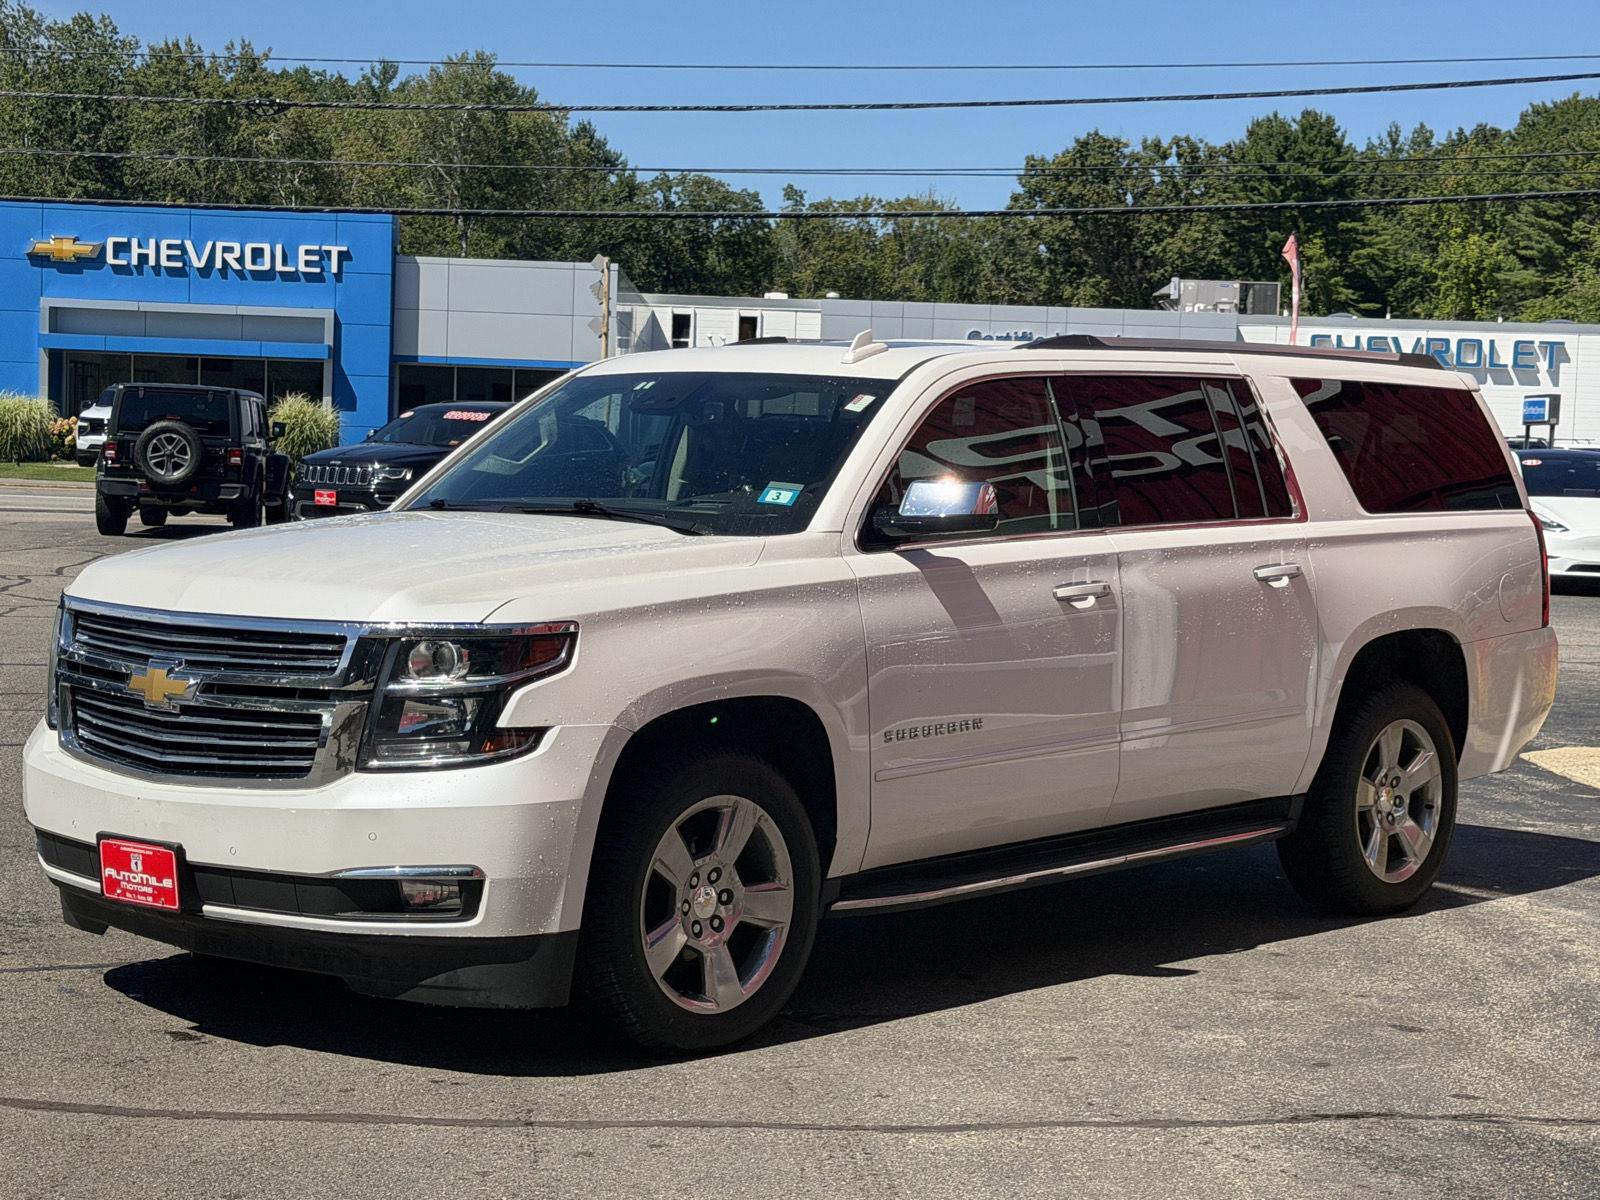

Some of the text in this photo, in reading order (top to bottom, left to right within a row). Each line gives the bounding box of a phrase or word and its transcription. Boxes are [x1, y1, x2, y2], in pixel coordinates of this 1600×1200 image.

[106, 236, 348, 274] CHEVROLET
[771, 491, 782, 501] 3
[883, 718, 984, 743] SUBURBAN
[105, 867, 173, 888] AUTOMILE
[120, 881, 153, 894] MOTORS
